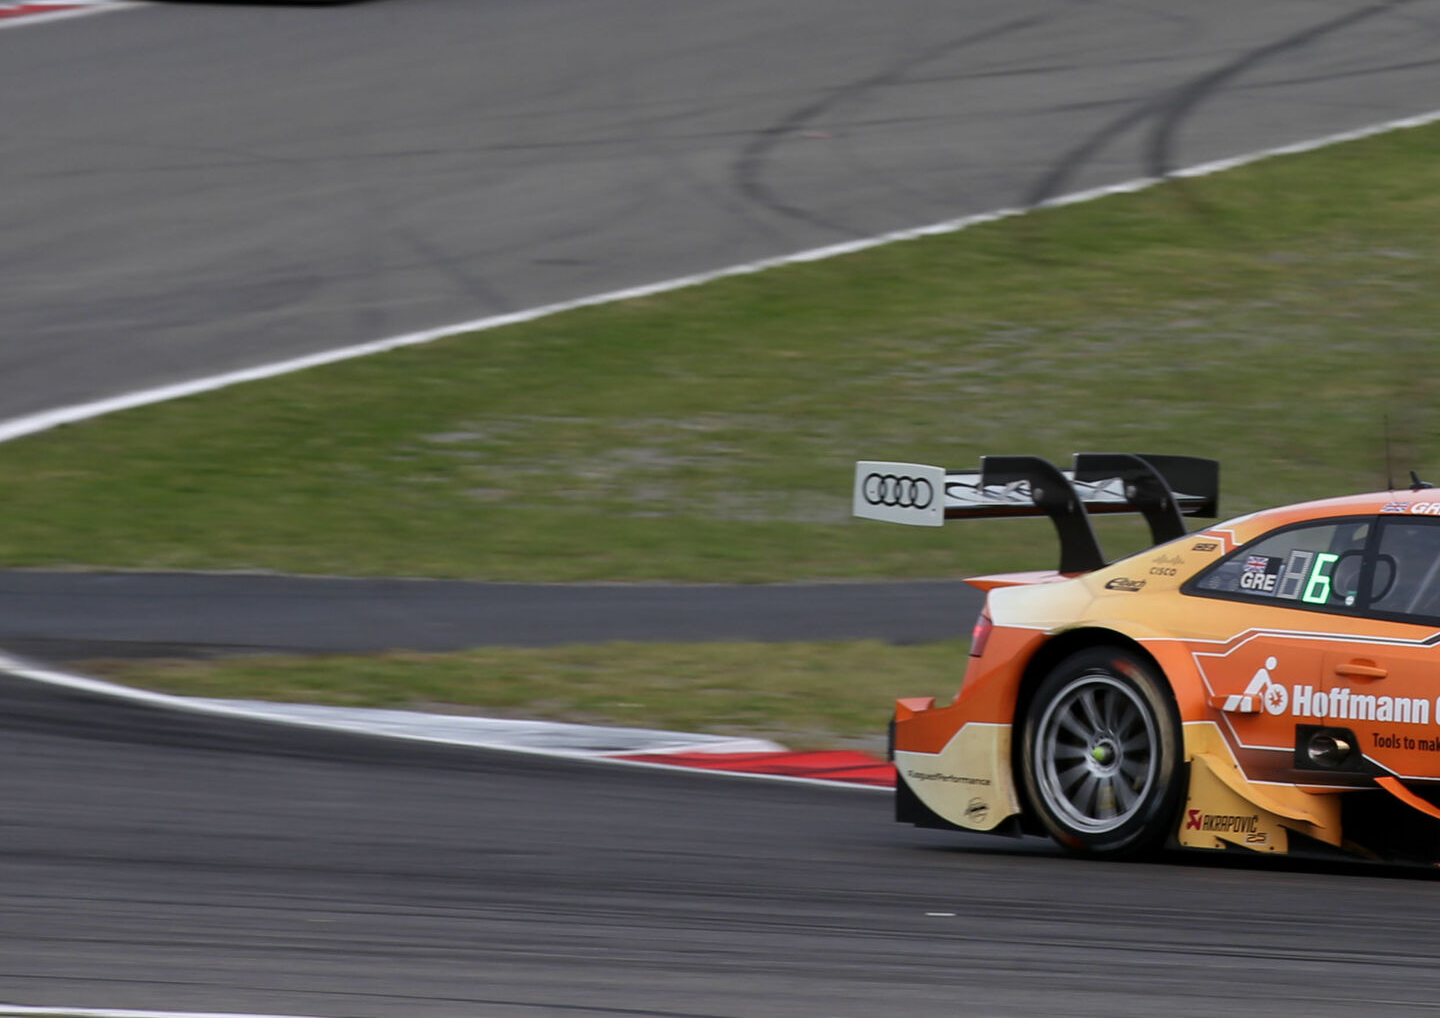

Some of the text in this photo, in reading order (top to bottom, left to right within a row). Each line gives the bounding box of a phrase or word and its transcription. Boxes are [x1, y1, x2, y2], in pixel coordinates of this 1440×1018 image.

[1240, 572, 1278, 591] GRE
[1291, 684, 1430, 725] Hoffmann
[1372, 732, 1401, 749] Tools
[1403, 735, 1416, 750] to
